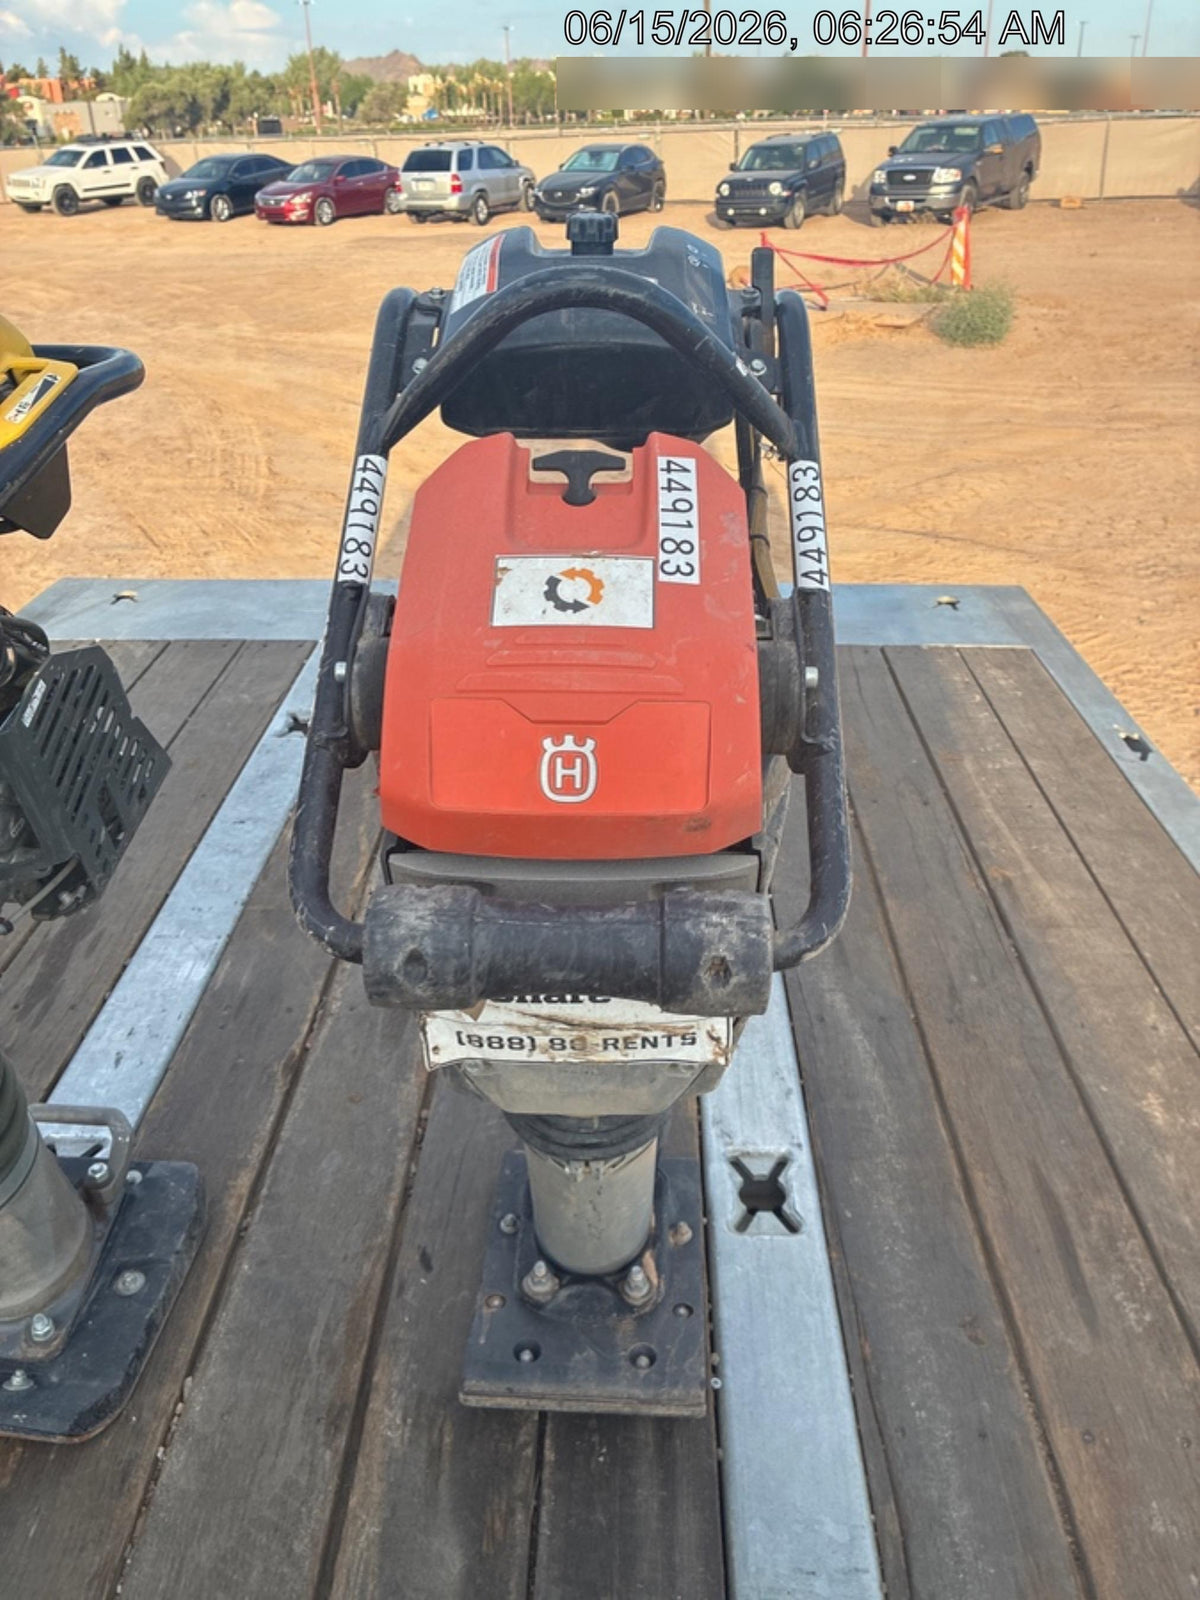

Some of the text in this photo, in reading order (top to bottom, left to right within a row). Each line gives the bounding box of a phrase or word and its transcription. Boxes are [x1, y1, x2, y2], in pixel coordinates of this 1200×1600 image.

[340, 458, 383, 579] 449183
[660, 459, 695, 577] 449183
[792, 466, 828, 586] 449183
[455, 1030, 537, 1052] (888)
